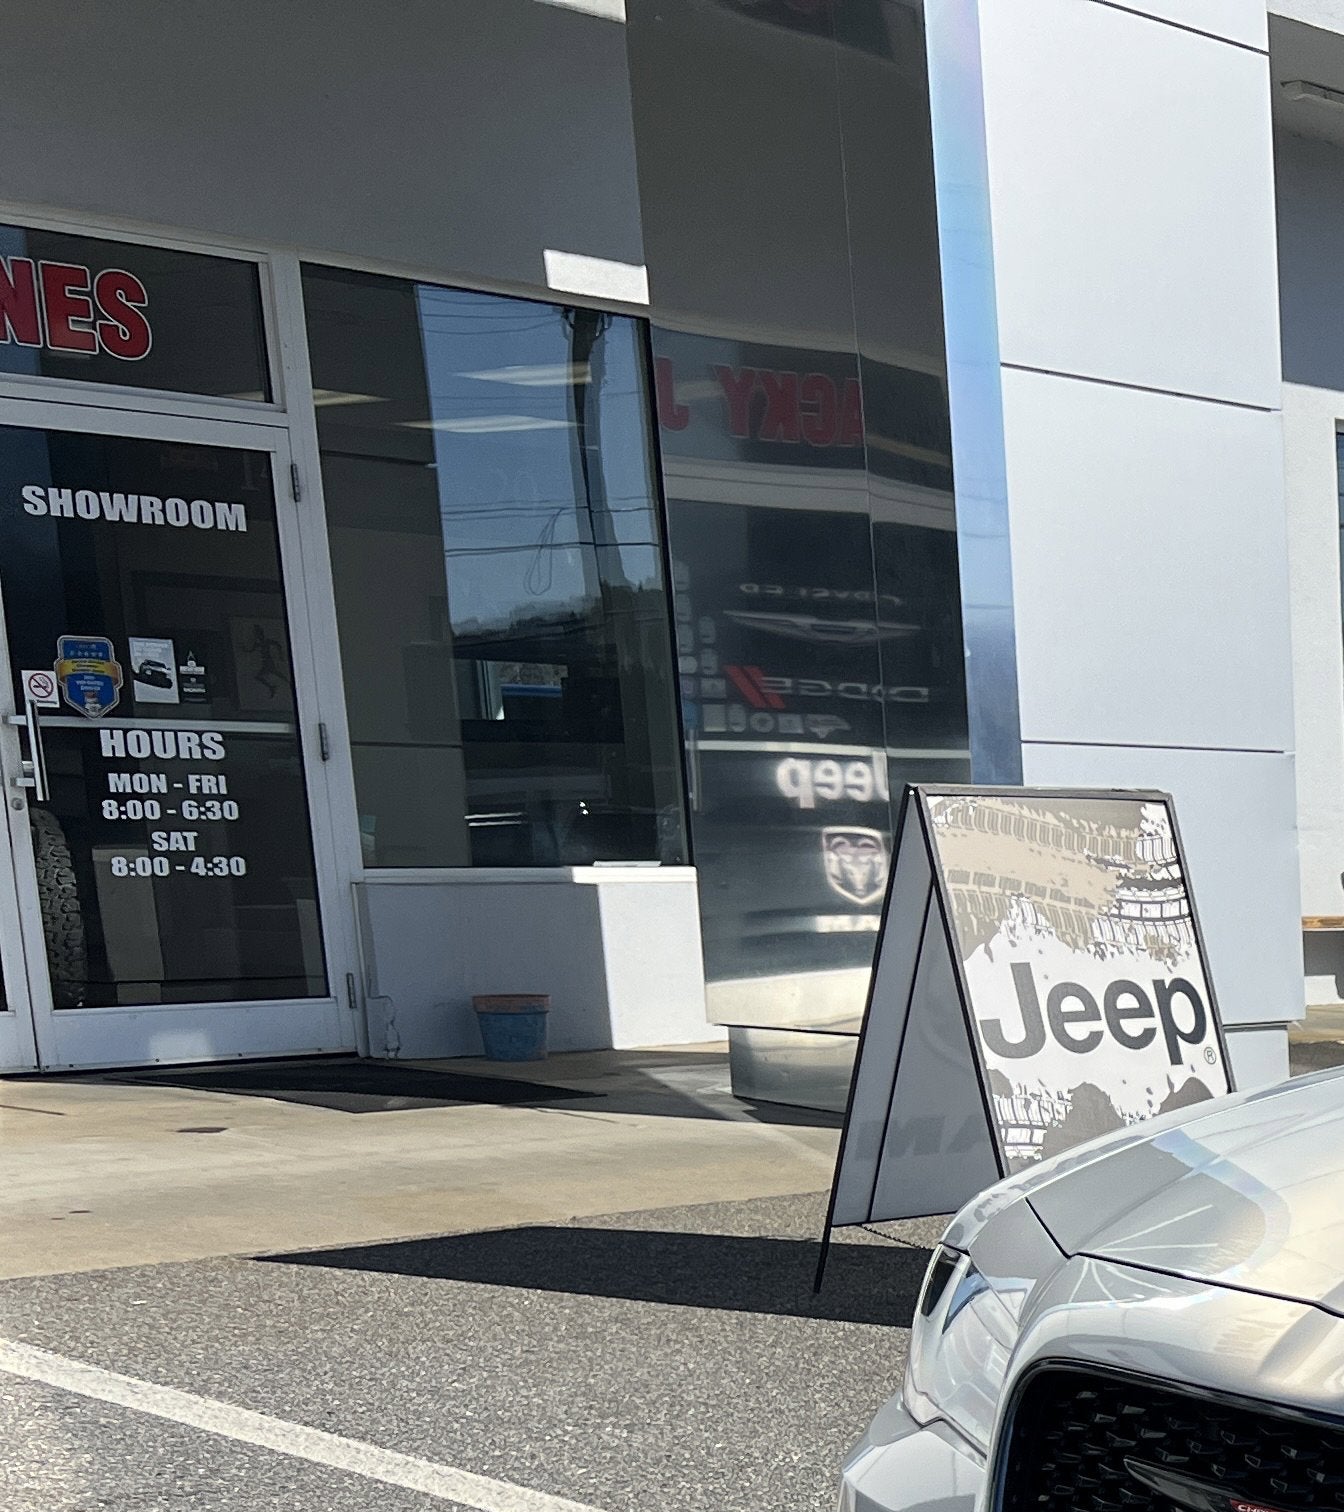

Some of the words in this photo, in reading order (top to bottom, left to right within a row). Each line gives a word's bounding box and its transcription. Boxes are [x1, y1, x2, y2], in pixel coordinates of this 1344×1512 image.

[21, 485, 248, 532] SHOWROOM
[100, 729, 226, 760] HOURS
[107, 773, 168, 794] MON
[187, 774, 228, 795] FRI
[101, 799, 161, 820] 8:00
[181, 800, 240, 821] 6:30
[151, 831, 199, 852] SAT
[111, 856, 171, 877] 8:00
[190, 856, 247, 877] 4:30
[978, 961, 1207, 1067] Jeep
